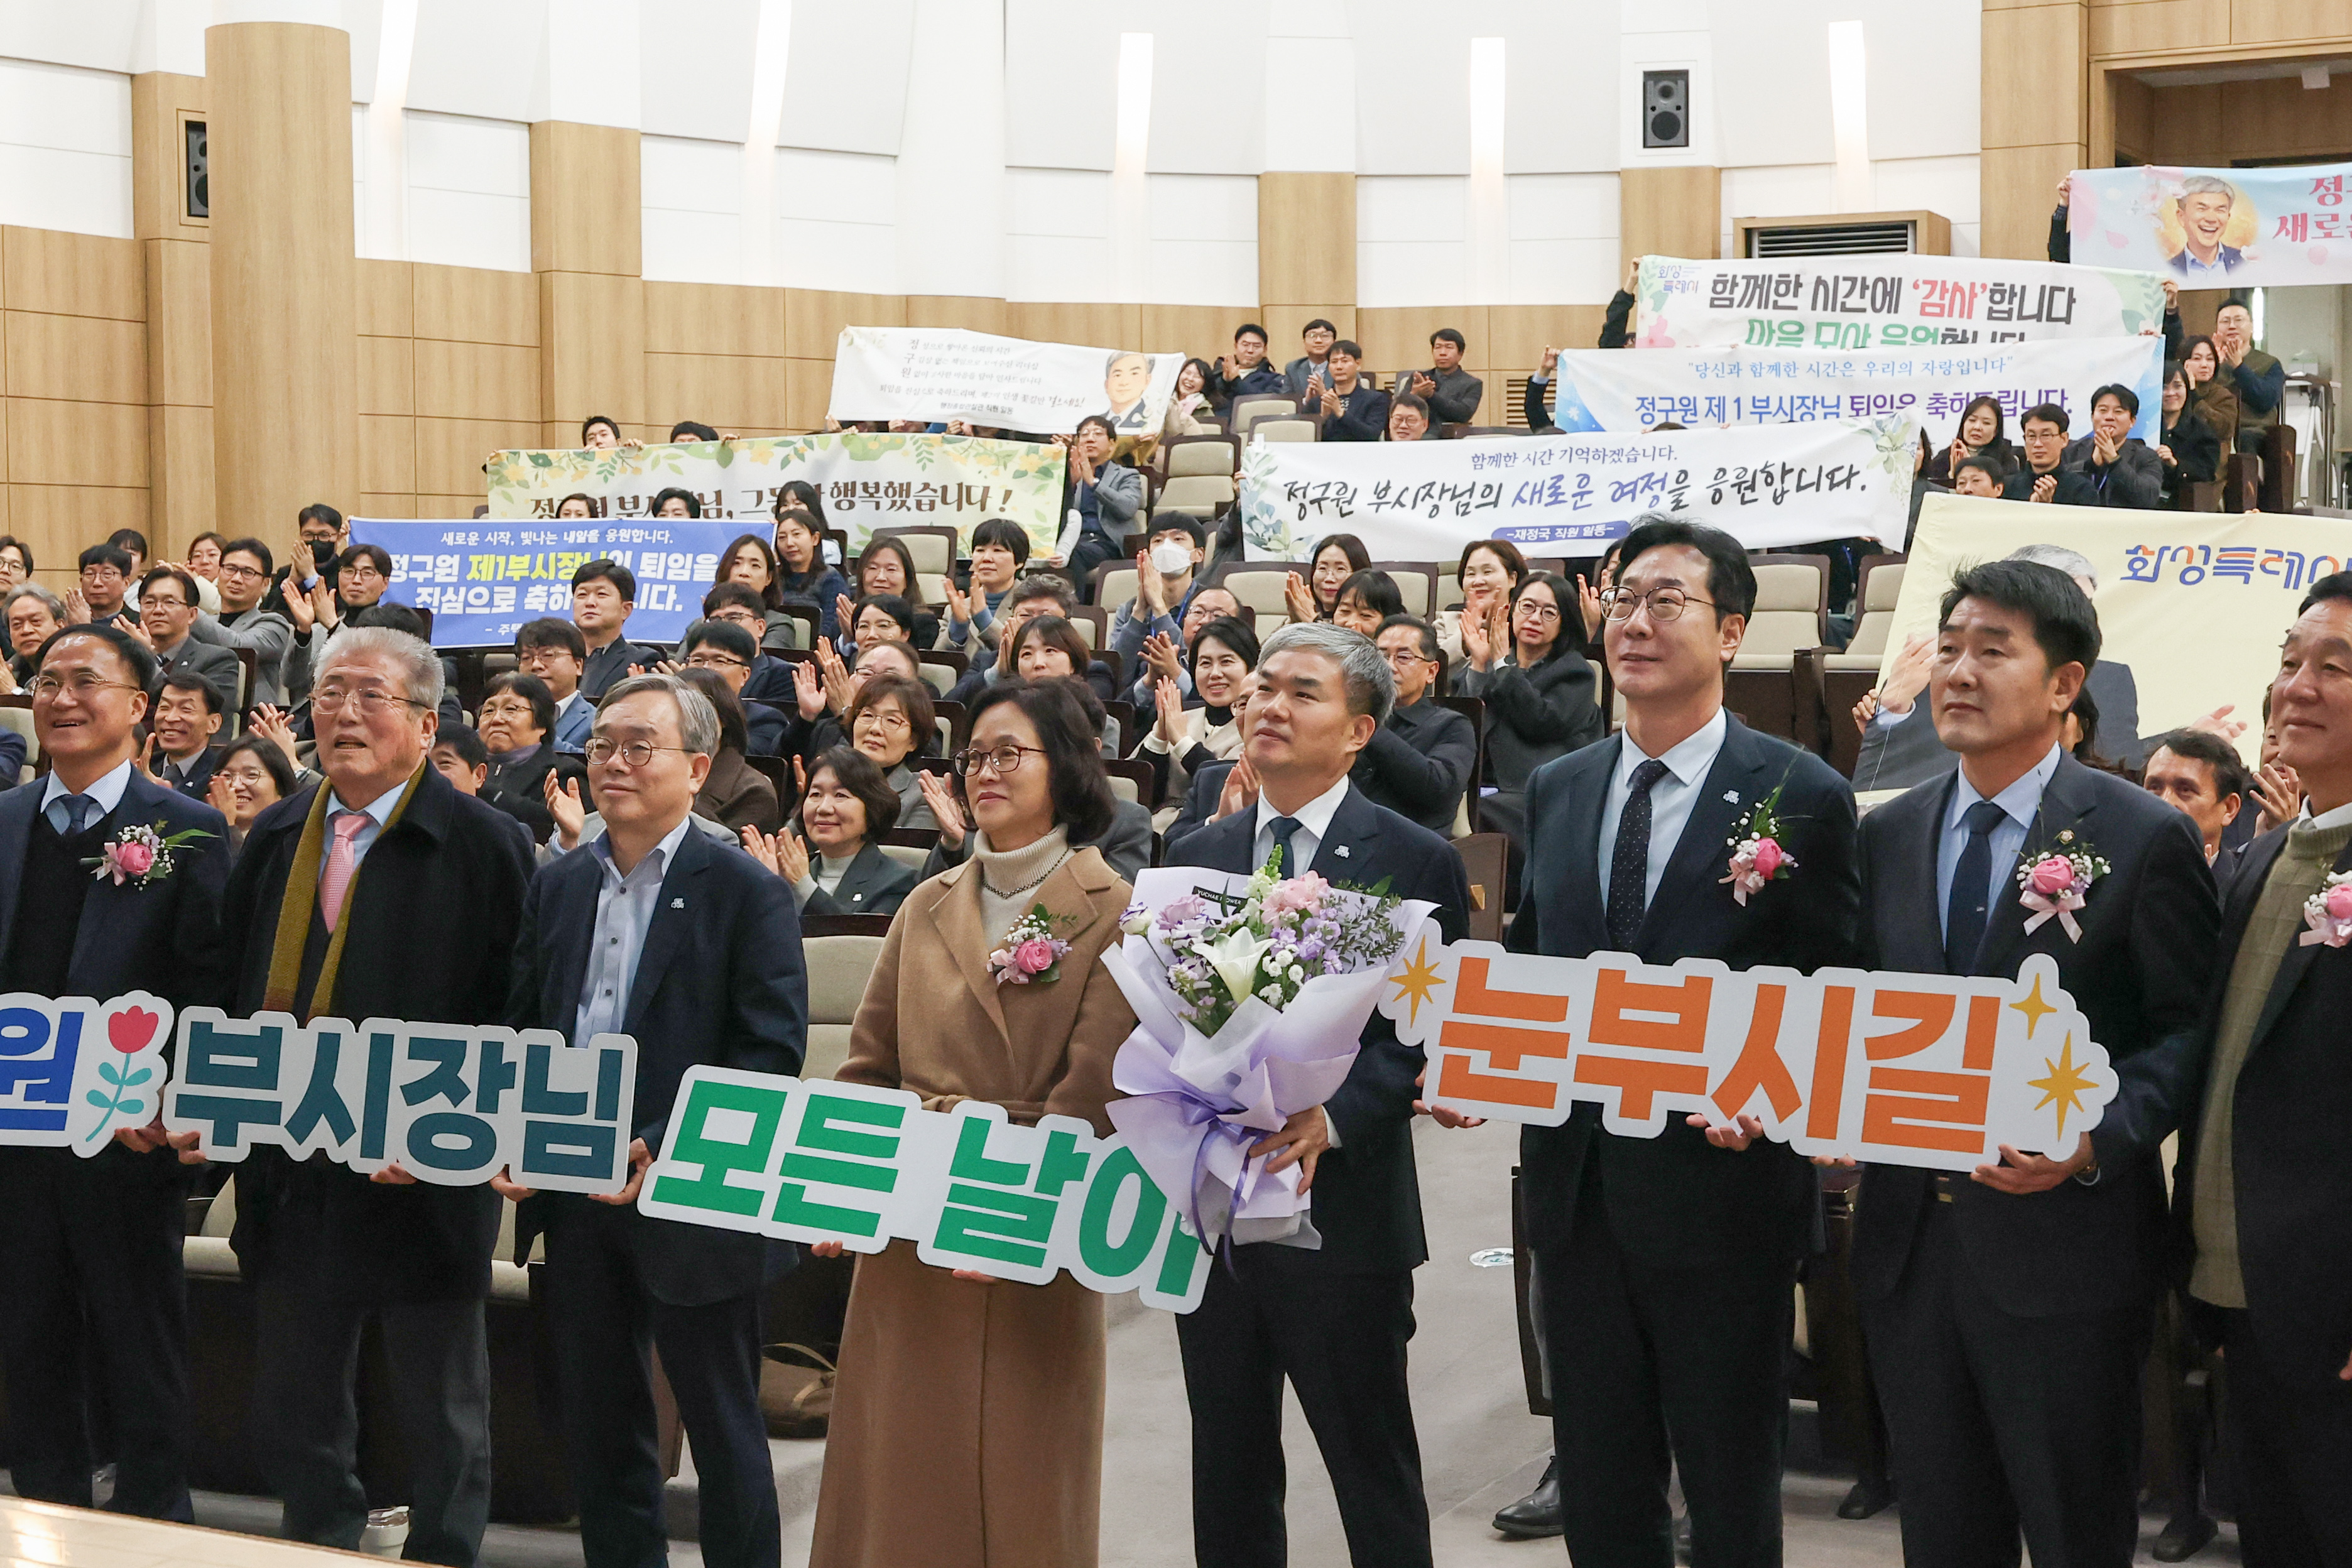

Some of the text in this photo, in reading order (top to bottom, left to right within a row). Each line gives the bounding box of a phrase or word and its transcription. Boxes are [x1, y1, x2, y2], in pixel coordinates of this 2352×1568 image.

[2309, 175, 2352, 206] 정
[2272, 212, 2352, 242] 새로
[1709, 274, 1803, 310] 함께한
[1811, 275, 1902, 314] 시간에
[1750, 361, 1798, 378] 함께한
[1806, 361, 1856, 378] 시간은
[1863, 361, 1913, 378] 우리의
[1635, 396, 1698, 425] 정구원
[1705, 396, 1726, 423] 제
[1733, 397, 1741, 420] 1
[1750, 395, 1841, 424] 부시장님
[1471, 445, 1678, 471] 함께한 시간 기억하겠습니다.
[1283, 460, 1866, 521] 정구원 부시장님의 새로운 여정을 응원합니다.
[441, 528, 673, 547] 새로운 시작, 빛나는 내일을 응원합니다.
[1555, 526, 1579, 538] 직원
[389, 553, 460, 583] 정구원
[638, 552, 719, 582] 퇴임을
[415, 584, 683, 615] 진심으로 축하니다.
[1197, 890, 1219, 900] YUCHAE
[1437, 956, 2001, 1154] 눈부시길
[175, 1021, 623, 1180] 부시장님
[651, 1079, 906, 1238] 모든
